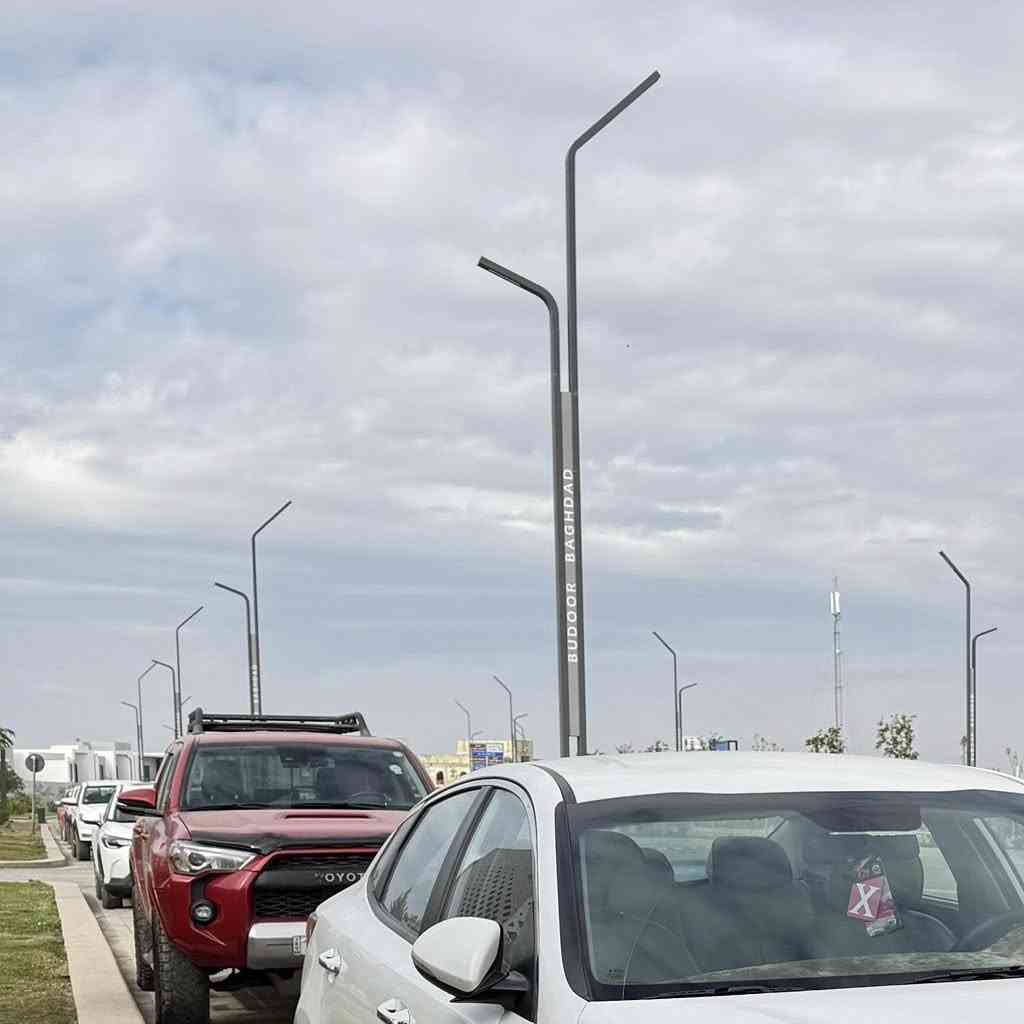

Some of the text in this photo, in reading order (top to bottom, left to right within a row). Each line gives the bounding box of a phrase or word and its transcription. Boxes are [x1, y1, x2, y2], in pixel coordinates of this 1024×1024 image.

[563, 468, 578, 664] BUDOOR BAGHDAD
[848, 882, 881, 918] X
